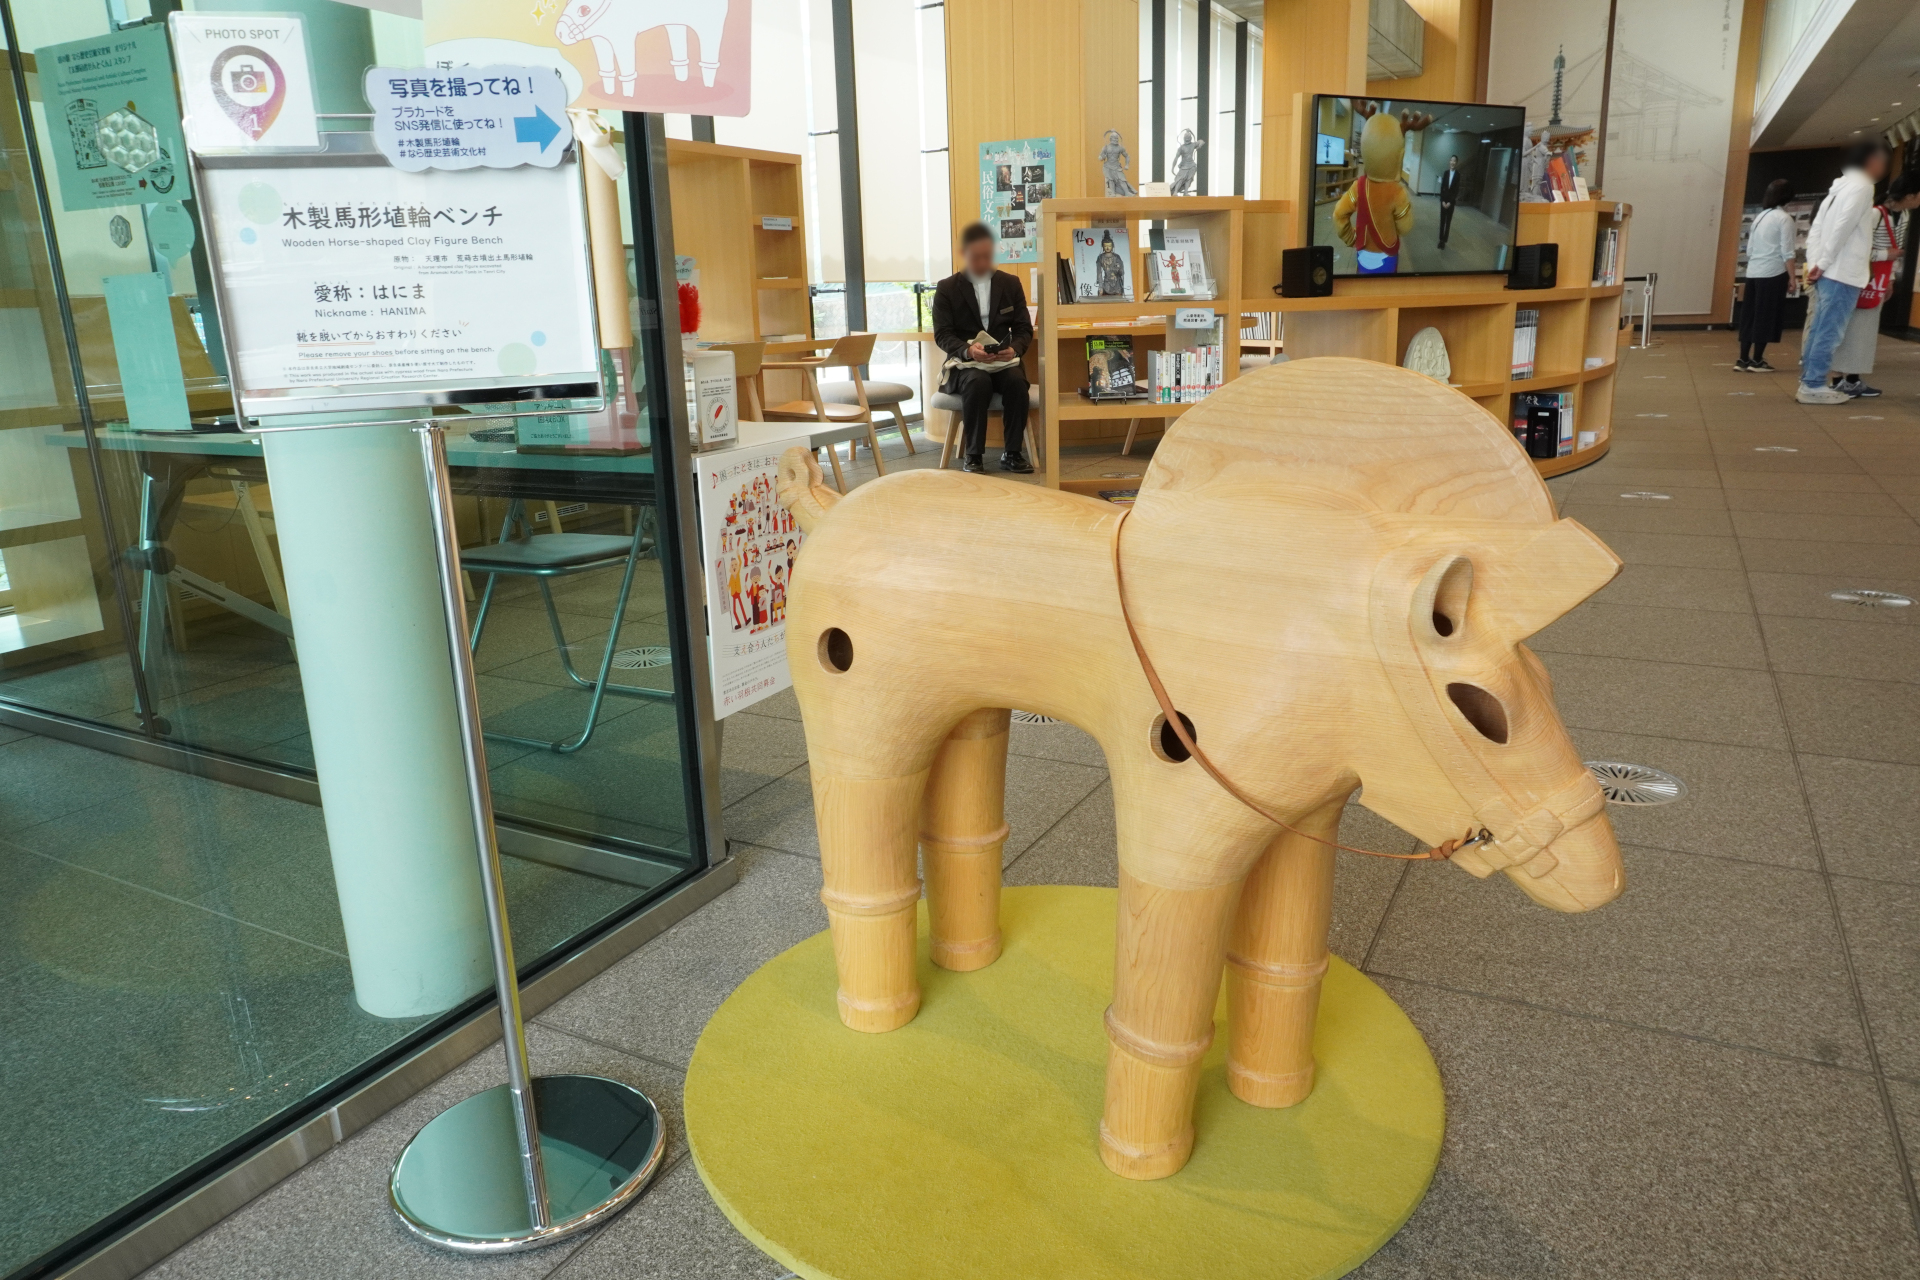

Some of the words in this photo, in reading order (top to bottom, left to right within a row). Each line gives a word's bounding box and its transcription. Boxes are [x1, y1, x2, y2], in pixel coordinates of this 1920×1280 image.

[205, 29, 246, 39] PHOTO
[250, 29, 280, 39] SPOT
[388, 76, 534, 98] 写真を撮ってね！
[391, 105, 455, 119] プラカードを
[250, 114, 262, 131] 1
[394, 117, 503, 131] SNS発信に使ってね！
[282, 205, 503, 230] 木製馬形埴輪ベンチ
[281, 238, 325, 247] Wooden
[328, 237, 404, 248] Horse-shaped
[407, 237, 431, 247] Clay
[434, 236, 468, 247] Figure
[471, 236, 503, 245] Bench
[314, 283, 426, 303] 愛称：はにま
[380, 307, 427, 316] HANIMA
[296, 328, 463, 343] 靴を脱いでからおすわりください
